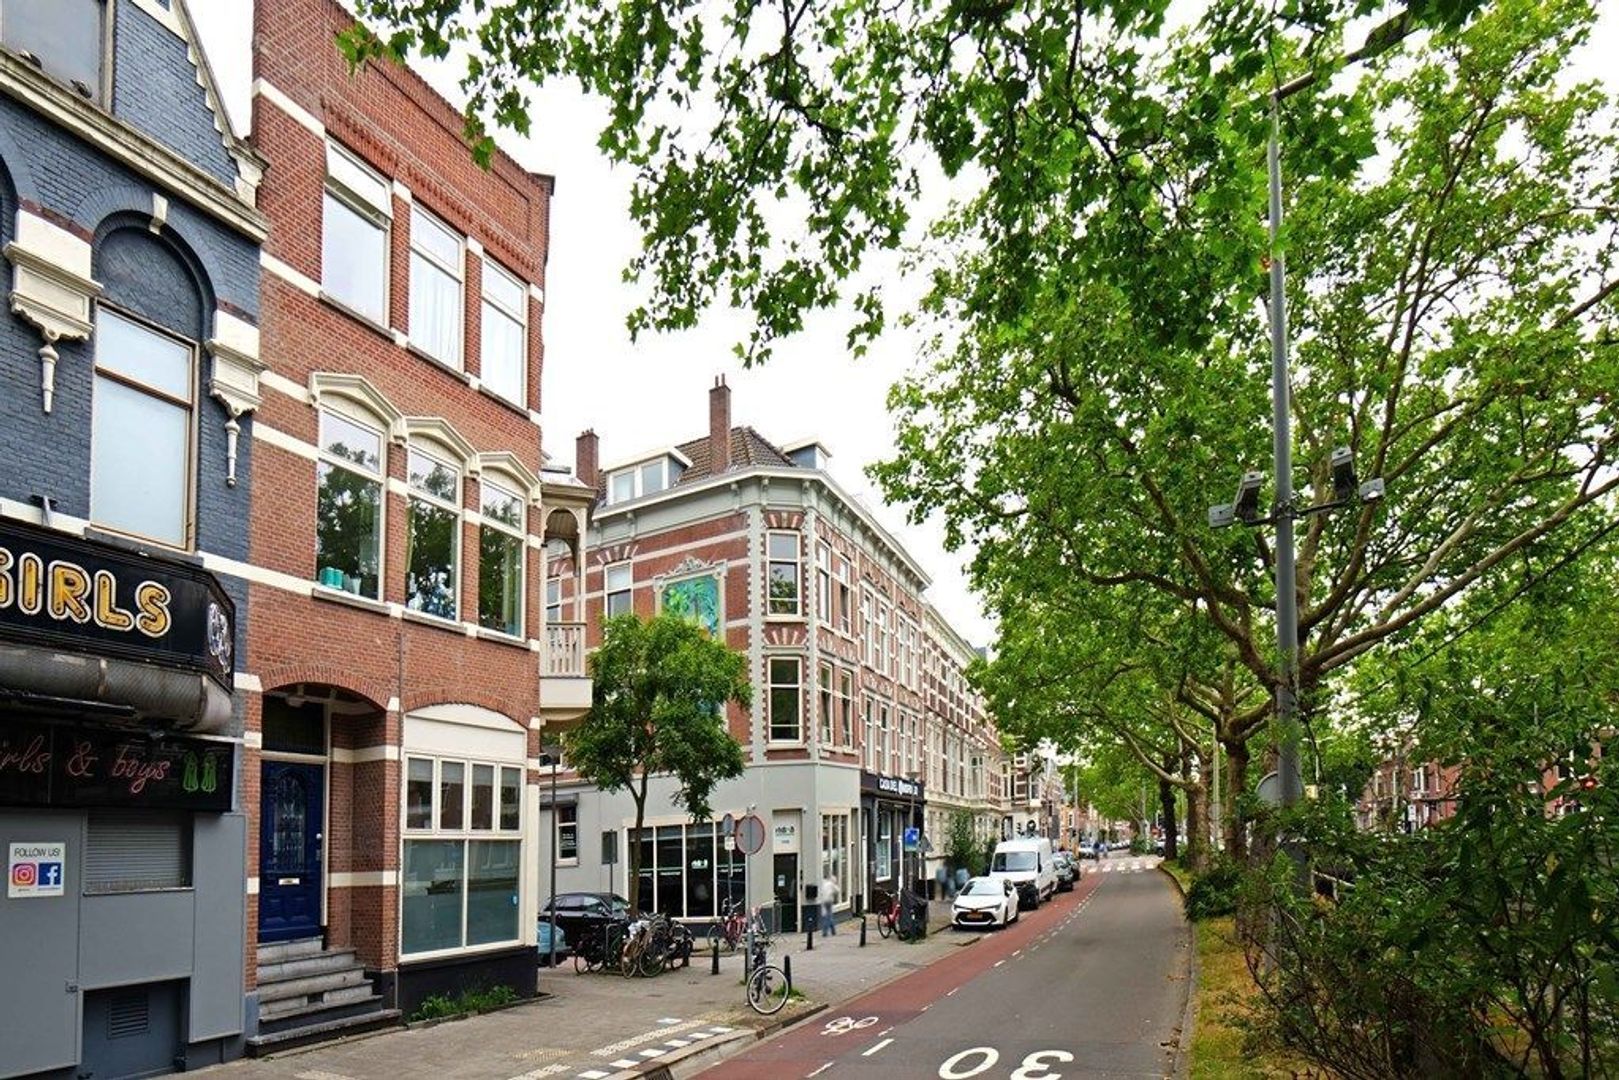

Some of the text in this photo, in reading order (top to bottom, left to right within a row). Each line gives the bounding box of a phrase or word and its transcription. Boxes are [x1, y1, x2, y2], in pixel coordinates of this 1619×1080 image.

[67, 742, 99, 776] &
[112, 745, 170, 793] boys
[14, 847, 46, 857] FOLLOW
